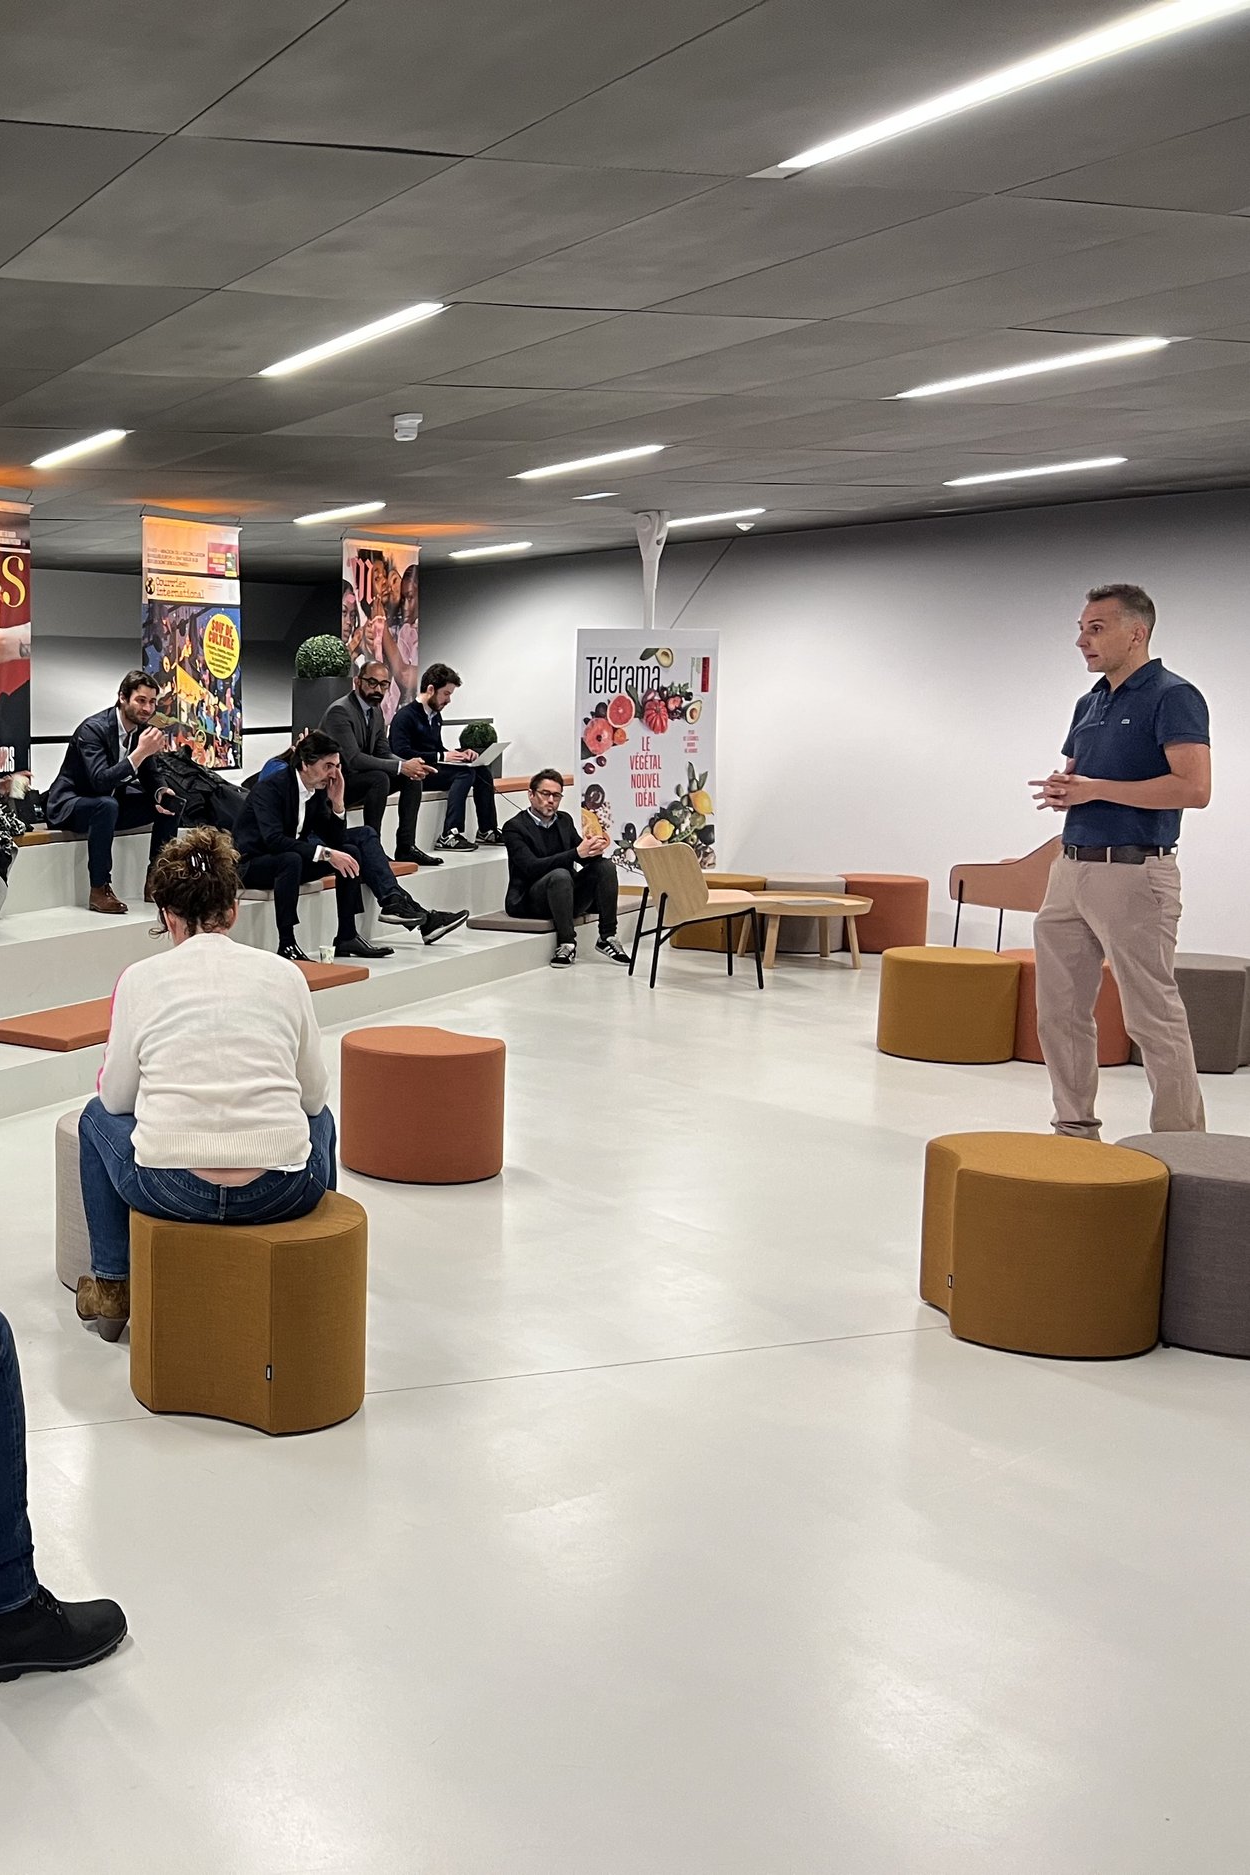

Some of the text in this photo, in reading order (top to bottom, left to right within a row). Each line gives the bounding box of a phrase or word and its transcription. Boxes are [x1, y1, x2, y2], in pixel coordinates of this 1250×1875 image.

[586, 656, 661, 694] Télérama
[641, 736, 651, 752] LE
[630, 752, 662, 770] VÉGÉTAL
[630, 773, 661, 789] NOUVEL
[635, 789, 658, 807] IDÉAL
